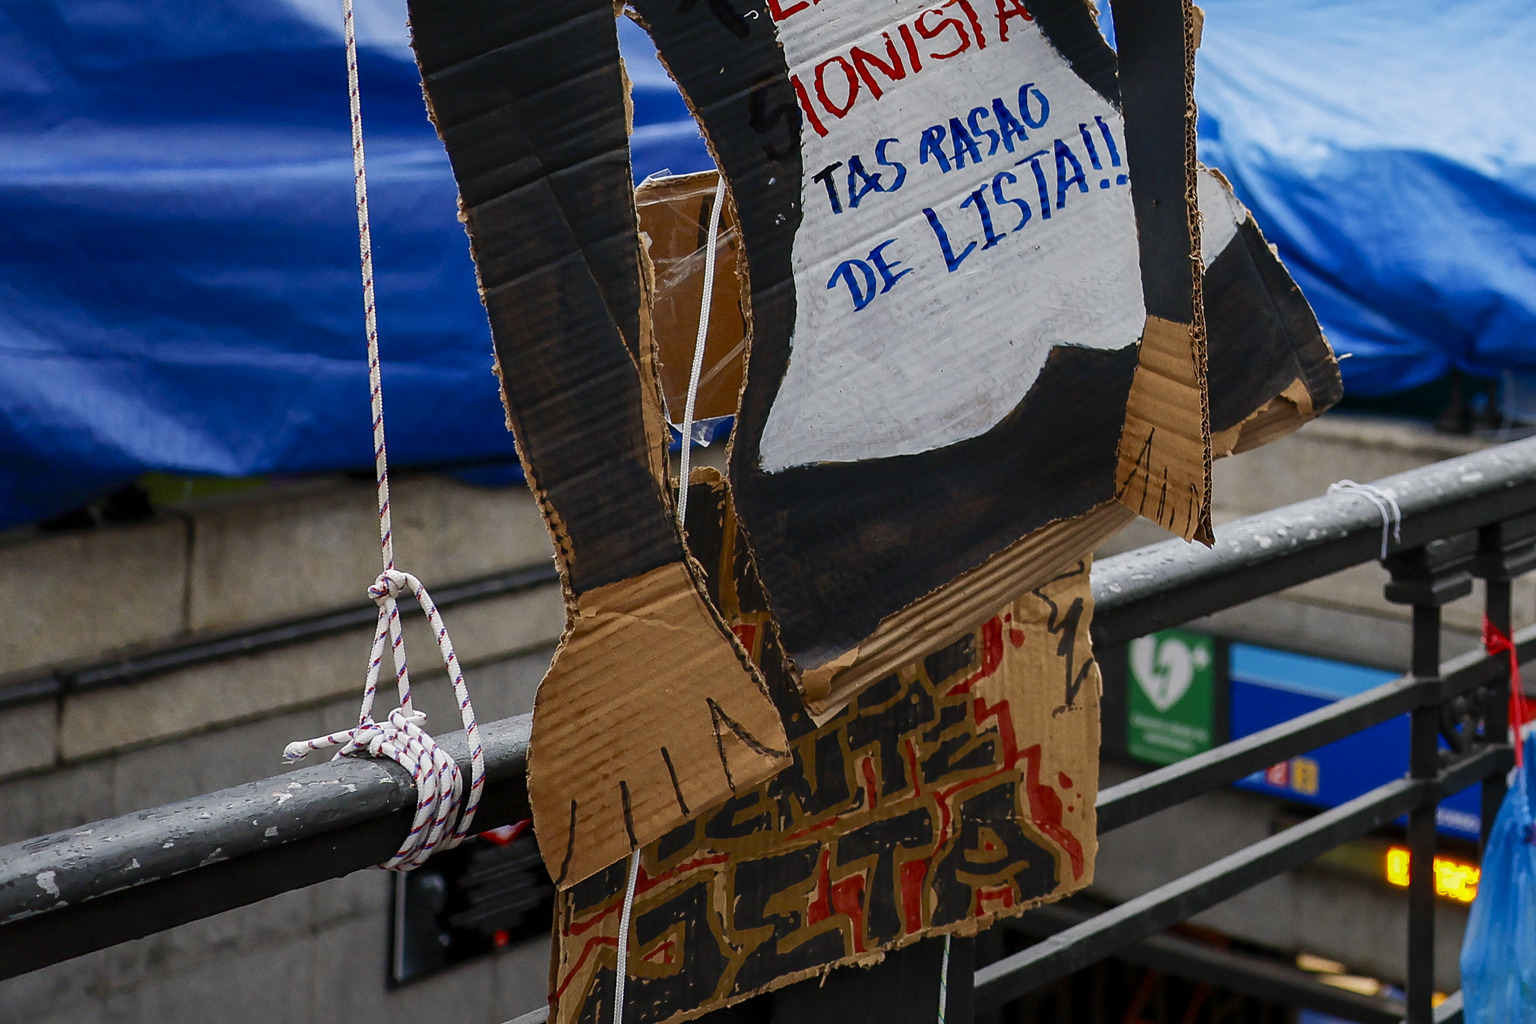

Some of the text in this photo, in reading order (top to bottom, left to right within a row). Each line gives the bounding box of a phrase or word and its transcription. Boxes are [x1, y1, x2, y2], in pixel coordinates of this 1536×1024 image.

[813, 138, 907, 214] TAS
[827, 115, 1129, 313] DE LISTA!!
